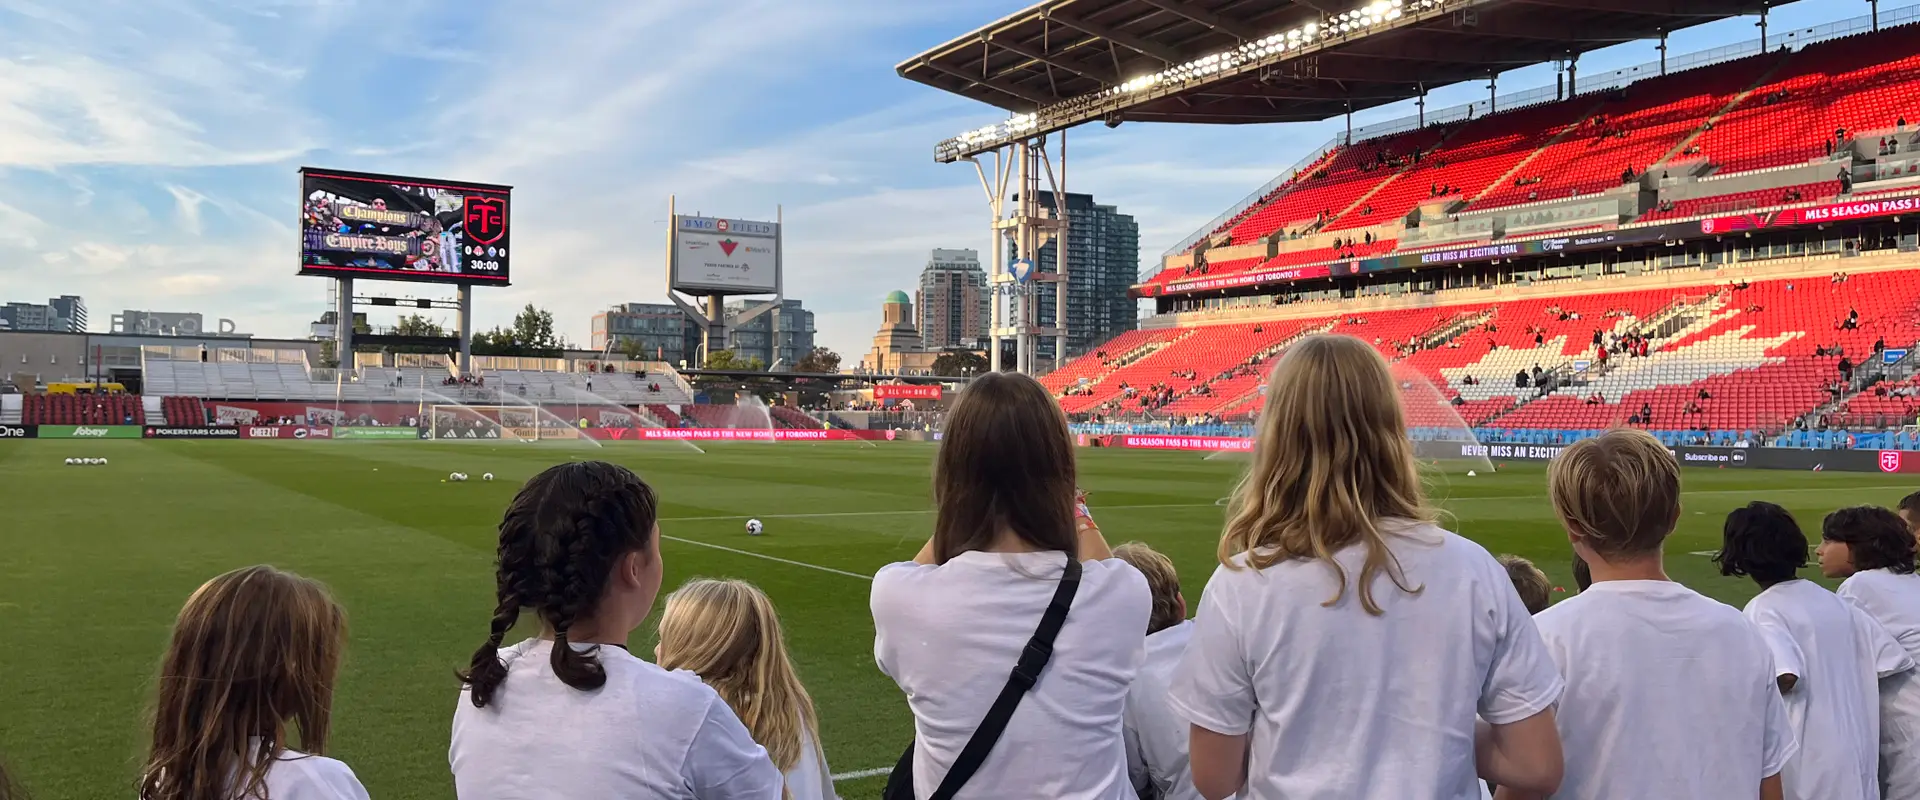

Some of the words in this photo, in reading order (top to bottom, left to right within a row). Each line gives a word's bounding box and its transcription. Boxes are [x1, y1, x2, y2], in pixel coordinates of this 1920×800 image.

[343, 206, 406, 223] Champions
[1806, 207, 1829, 220] MLS
[1832, 202, 1878, 217] SEASON
[1882, 198, 1912, 212] PASS
[1915, 198, 1920, 208] I
[684, 220, 712, 228] BMO
[732, 223, 770, 234] FIELD
[326, 234, 374, 252] Empire
[376, 236, 407, 254] Boys
[465, 246, 472, 255] 0
[499, 248, 506, 257] 0
[1422, 252, 1440, 263] NEVER
[1443, 251, 1457, 261] MISS
[1460, 250, 1468, 259] AN
[1470, 246, 1498, 258] EXCITING
[1501, 244, 1517, 254] GOAL
[471, 260, 498, 270] 30:00
[1176, 283, 1196, 291] SEASON
[1265, 272, 1293, 280] TORONTO
[0, 425, 25, 436] One
[1141, 438, 1164, 446] SEASON
[1166, 438, 1180, 447] PASS
[1190, 439, 1201, 447] THE
[1203, 440, 1218, 448] NEW
[1220, 440, 1240, 448] HOME
[1462, 445, 1488, 456] NEVER
[1491, 446, 1512, 457] MISS
[1514, 446, 1526, 457] AN
[1685, 453, 1718, 461] Subscribe
